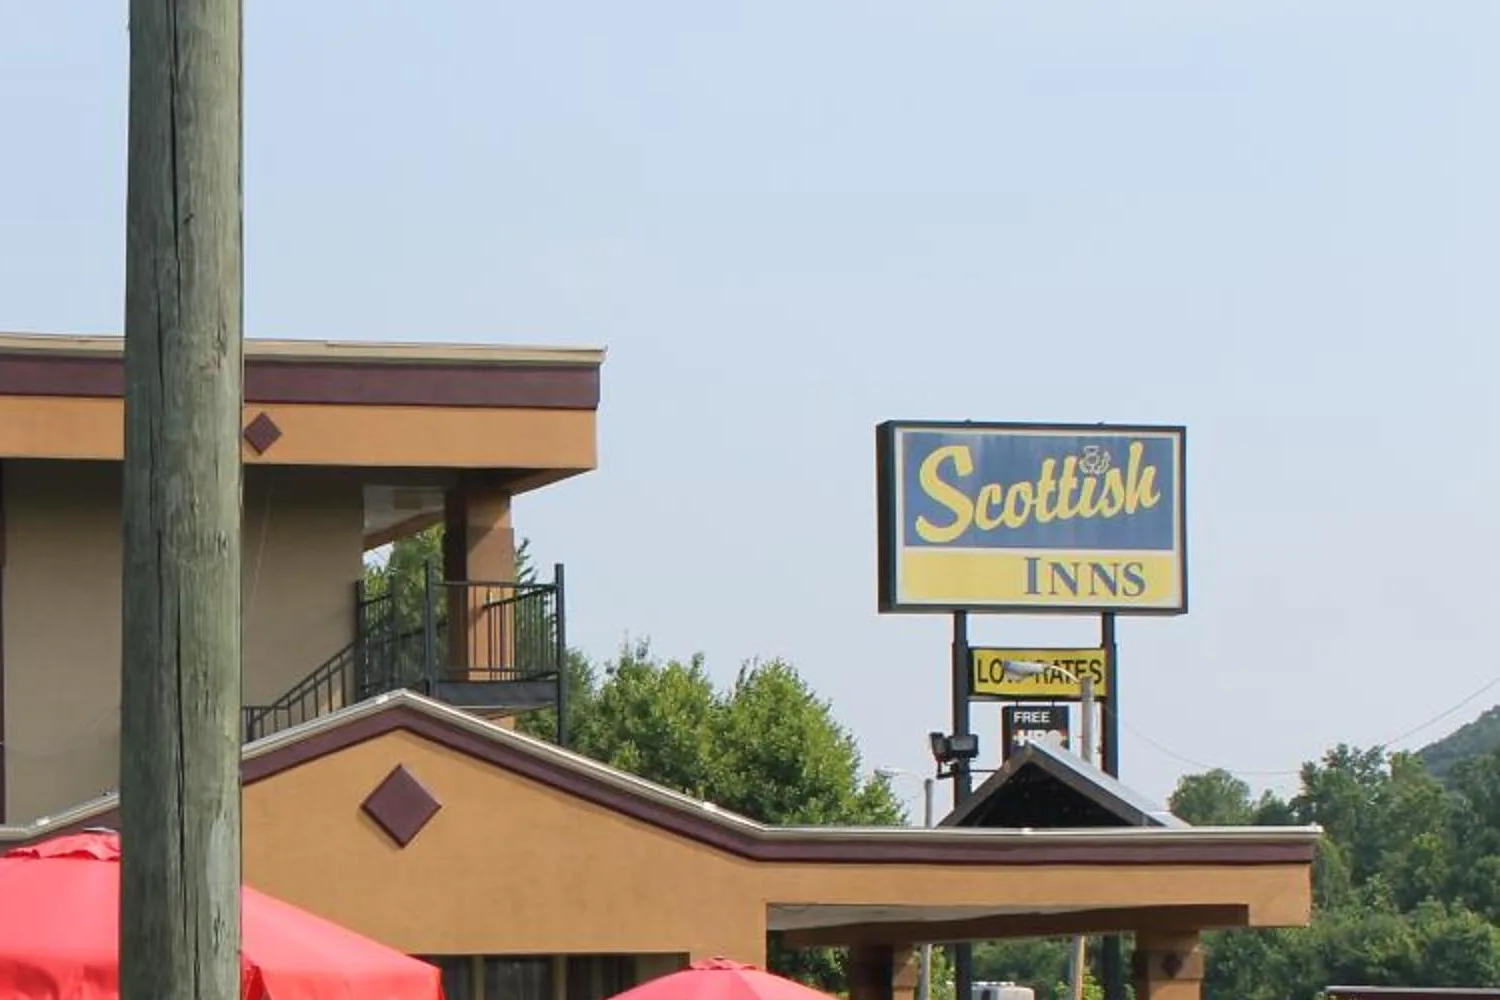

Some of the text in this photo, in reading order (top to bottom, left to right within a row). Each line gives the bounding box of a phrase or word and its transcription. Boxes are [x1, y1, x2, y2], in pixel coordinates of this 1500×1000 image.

[915, 441, 1160, 543] Scottish
[1024, 557, 1146, 597] INNS
[977, 658, 1030, 684] LO
[1013, 711, 1051, 724] FREE
